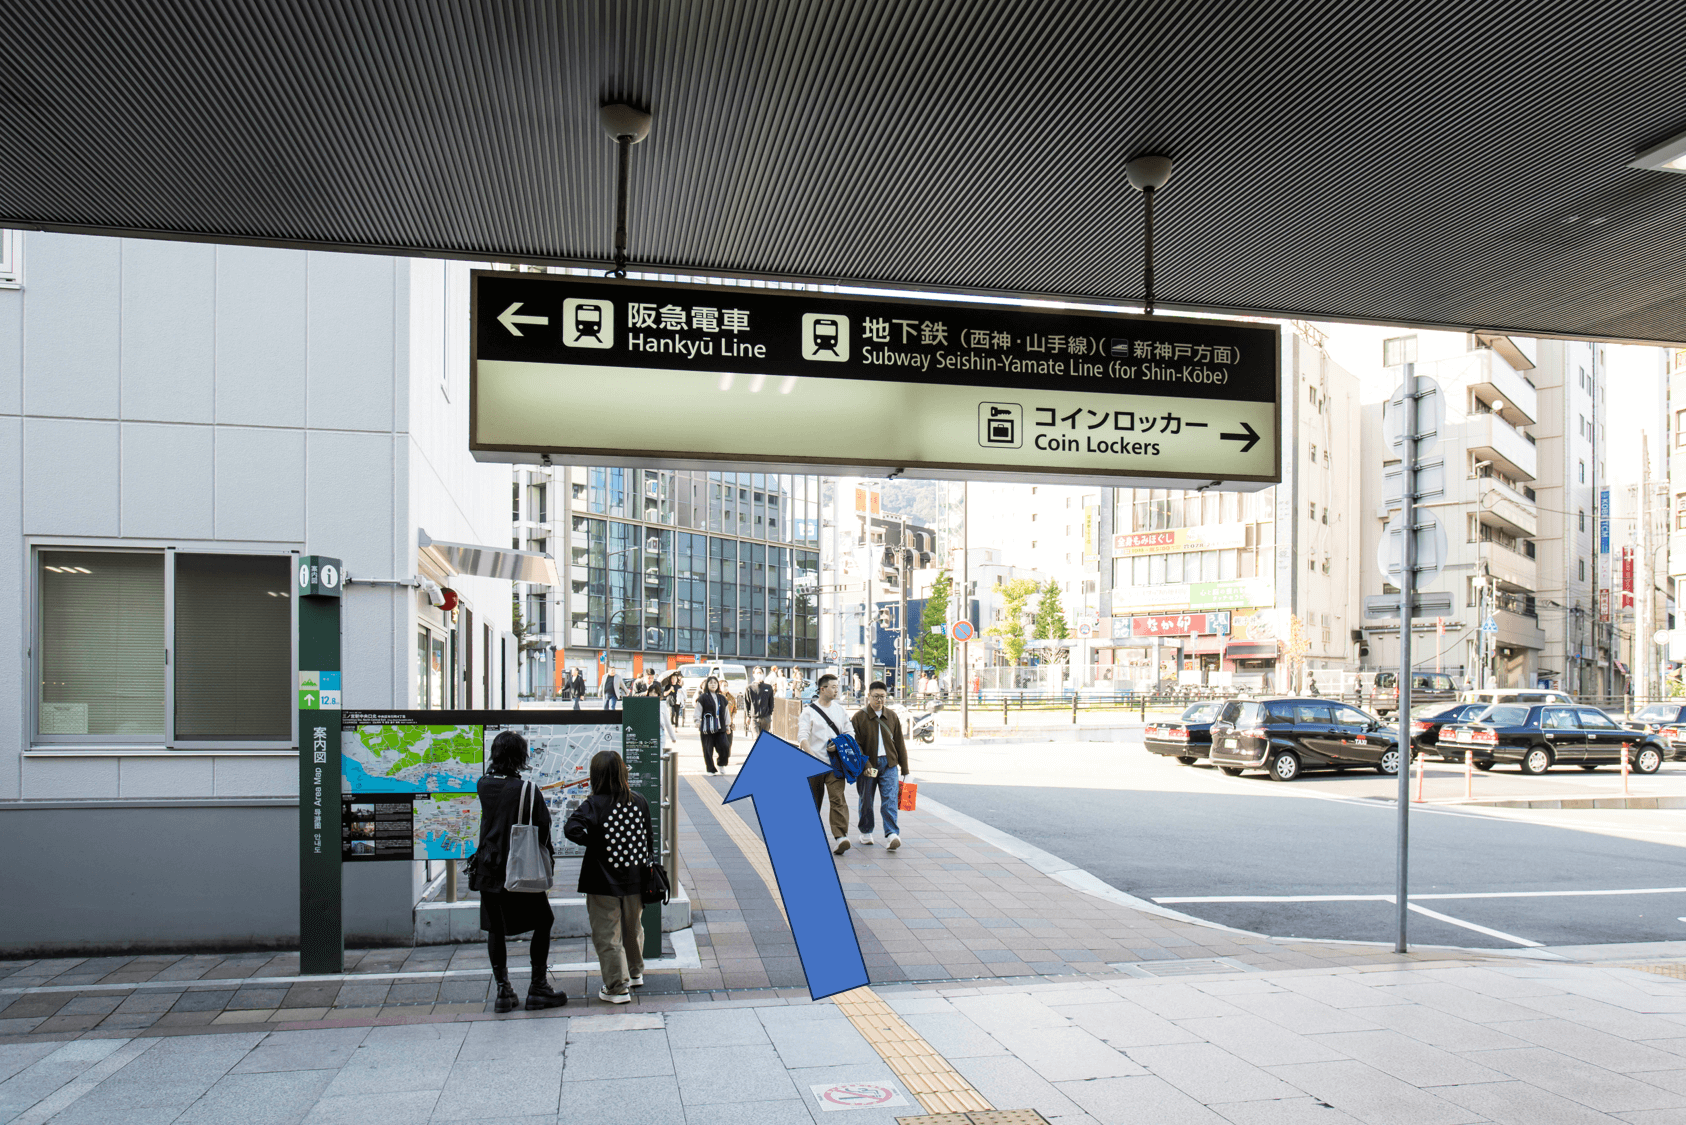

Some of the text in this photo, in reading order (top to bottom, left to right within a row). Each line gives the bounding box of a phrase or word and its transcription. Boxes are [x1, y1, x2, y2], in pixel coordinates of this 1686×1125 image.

[627, 301, 751, 335] 阪急電車
[861, 315, 949, 348] 地下鉄
[627, 332, 767, 359] Hankyū Line
[861, 346, 1230, 386] Subway Seishin-Yamate Line (for Shin-Kōbe)
[1034, 405, 1210, 436] コインロッカー
[1033, 433, 1161, 457] Coin Lockers
[1117, 533, 1173, 548] 全身もみほぐし
[1147, 615, 1191, 632] なか卯
[313, 726, 327, 764] 案内図
[313, 767, 322, 807] Area Map
